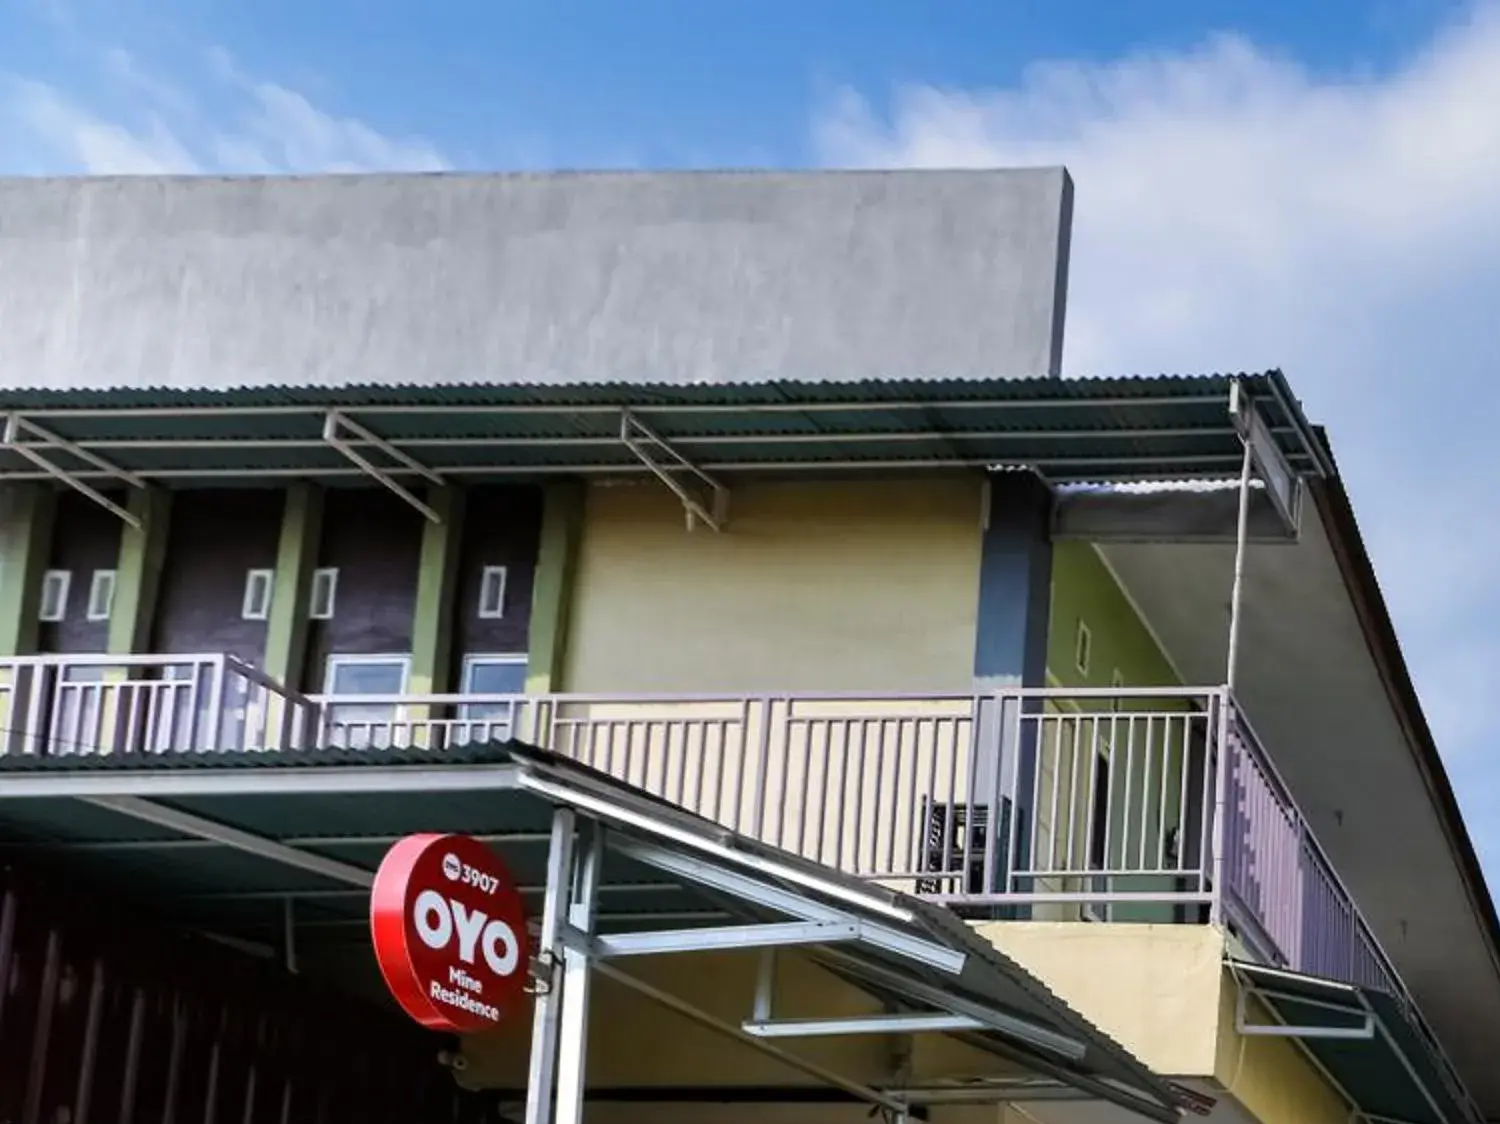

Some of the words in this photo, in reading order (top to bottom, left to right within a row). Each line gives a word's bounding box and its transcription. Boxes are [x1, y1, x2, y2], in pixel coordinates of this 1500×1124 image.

[461, 863, 499, 895] 3907
[413, 889, 519, 977] OYO
[430, 980, 499, 1022] Residence
